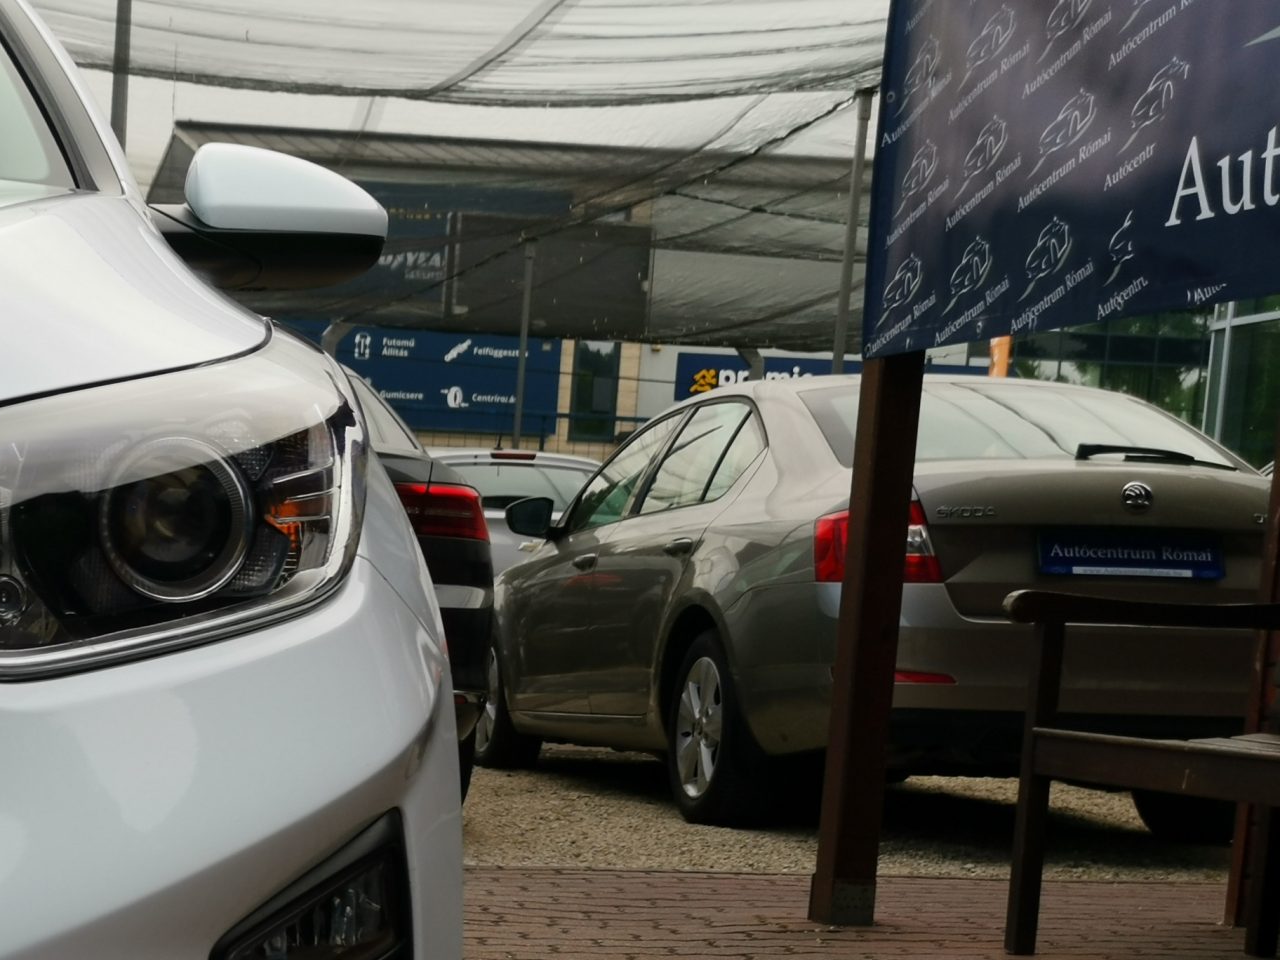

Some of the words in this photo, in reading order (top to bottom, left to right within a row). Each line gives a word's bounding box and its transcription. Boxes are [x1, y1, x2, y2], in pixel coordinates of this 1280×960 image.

[1083, 6, 1112, 44] Római
[945, 181, 994, 232] Autócentrum
[995, 153, 1021, 186] Római
[1018, 158, 1076, 212] Autócentrum
[1078, 127, 1111, 164] Római
[934, 304, 985, 346] Autócentrum
[985, 275, 1009, 306] Római
[1010, 286, 1066, 334] Autócentrum
[1065, 257, 1094, 288] Római
[1050, 544, 1156, 560] Autócentrum
[1162, 544, 1212, 561] Római
